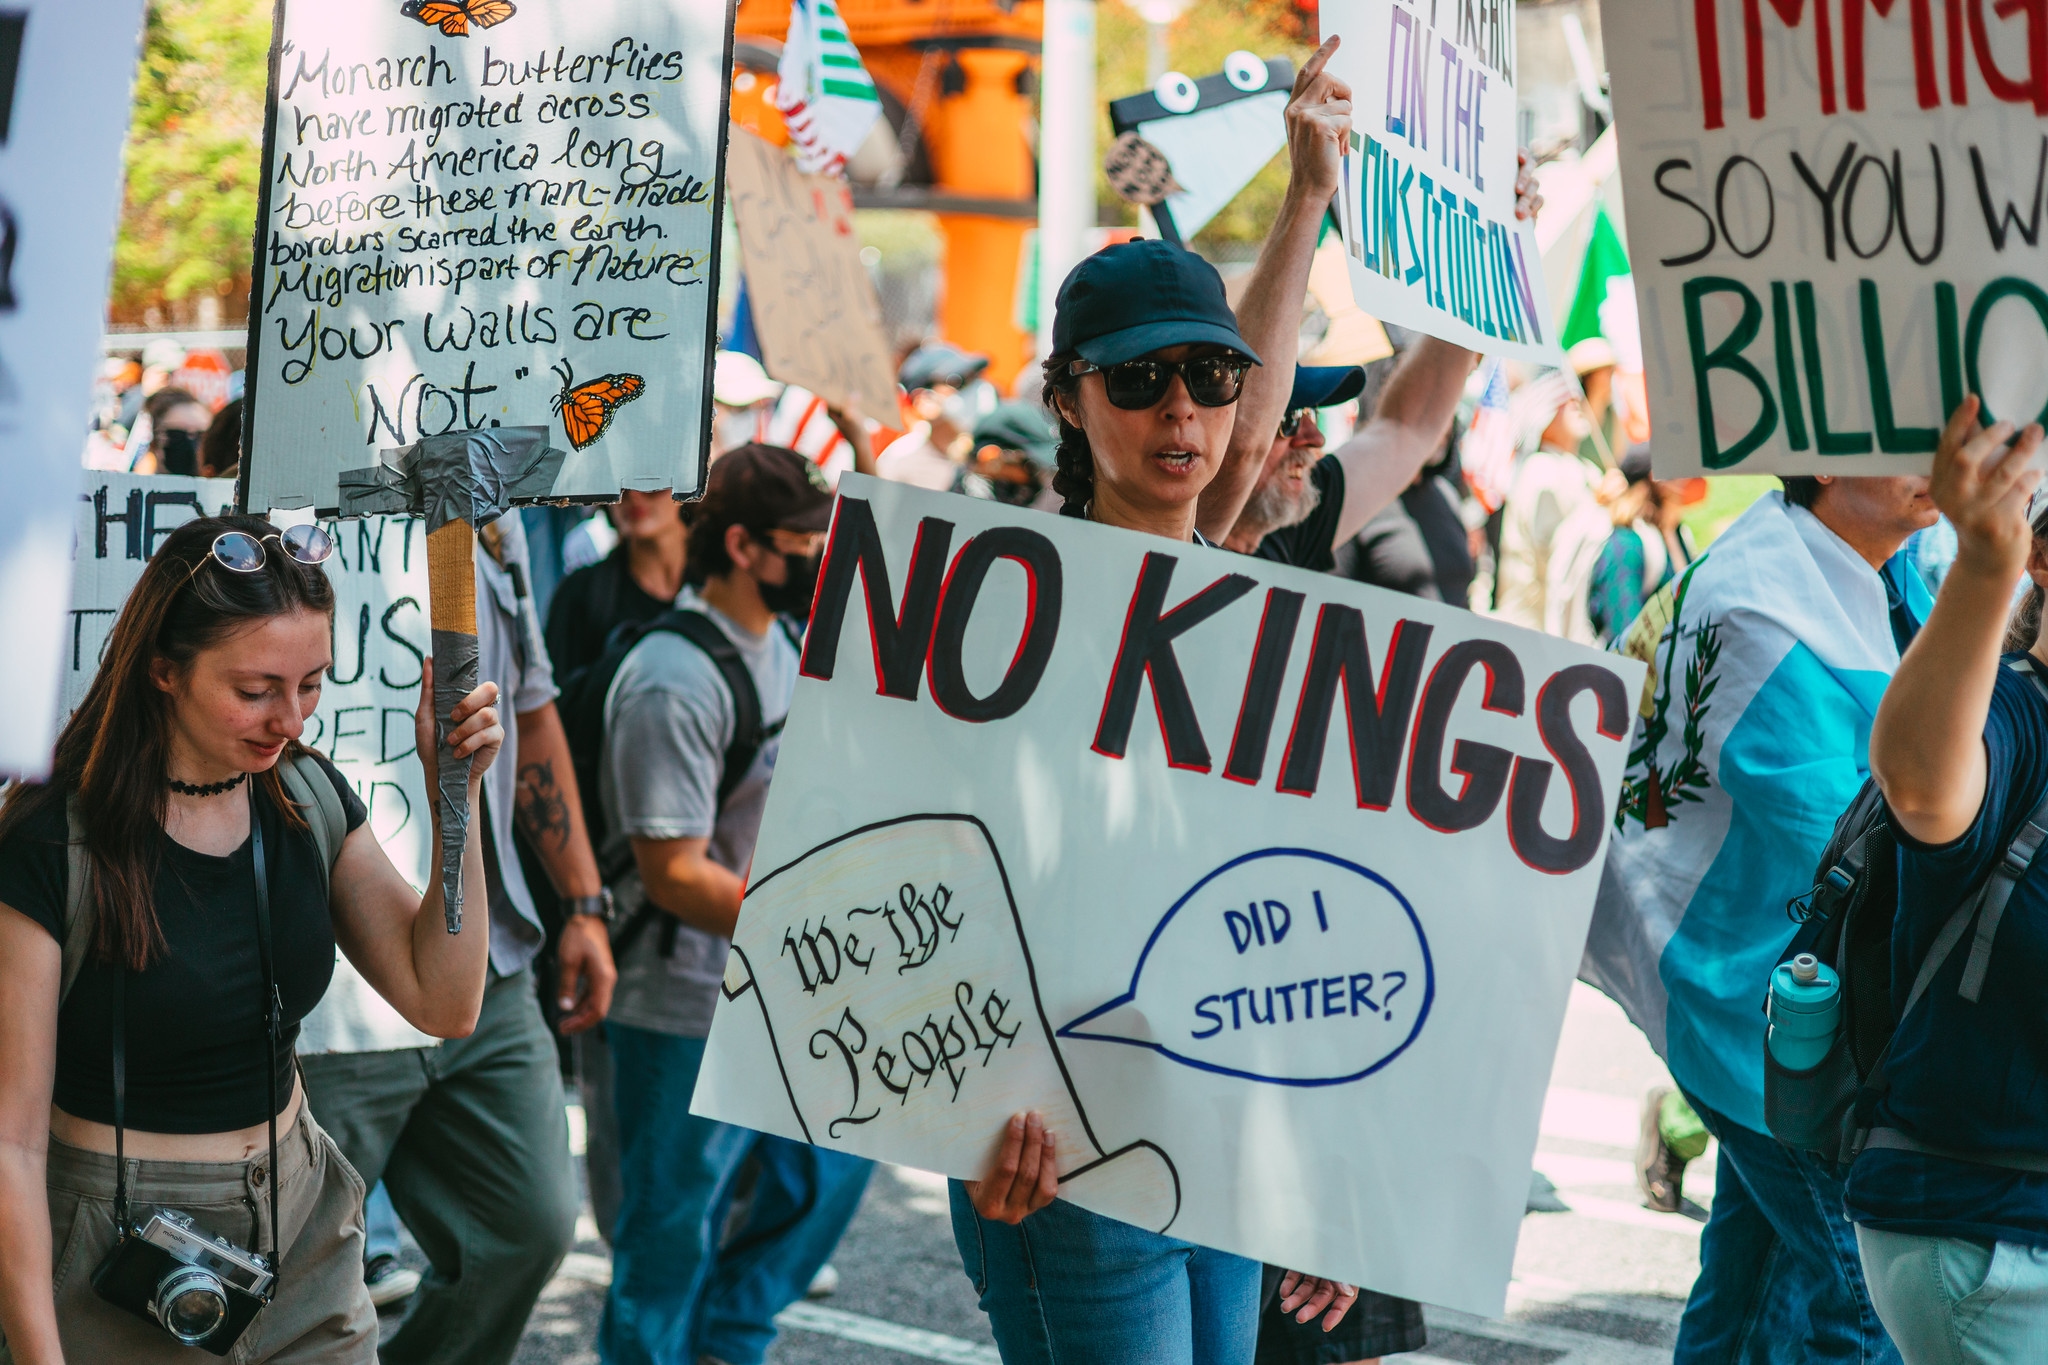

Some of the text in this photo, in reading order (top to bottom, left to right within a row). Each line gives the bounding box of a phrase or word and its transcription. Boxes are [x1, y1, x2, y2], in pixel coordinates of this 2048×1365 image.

[481, 37, 683, 87] butterflies
[1386, 4, 1432, 151] ON
[294, 92, 650, 148] have migrated across
[1441, 37, 1487, 194] THE
[277, 126, 682, 188] North America long
[275, 191, 405, 229] before
[409, 184, 497, 219] these
[1343, 130, 1543, 345] CONSTITUTION
[1654, 155, 1774, 267] SO
[1790, 141, 1945, 266] YOU
[269, 228, 384, 266] borders
[508, 215, 557, 244] the
[265, 254, 423, 315] Migration
[429, 256, 453, 286] is
[455, 254, 520, 295] part
[527, 249, 570, 280] of
[573, 302, 670, 341] are
[800, 494, 1630, 876] NO KINGS
[1224, 890, 1328, 954] DID I
[781, 915, 874, 997] We
[1191, 971, 1407, 1039] STUTTER?
[809, 981, 1021, 1139] People
